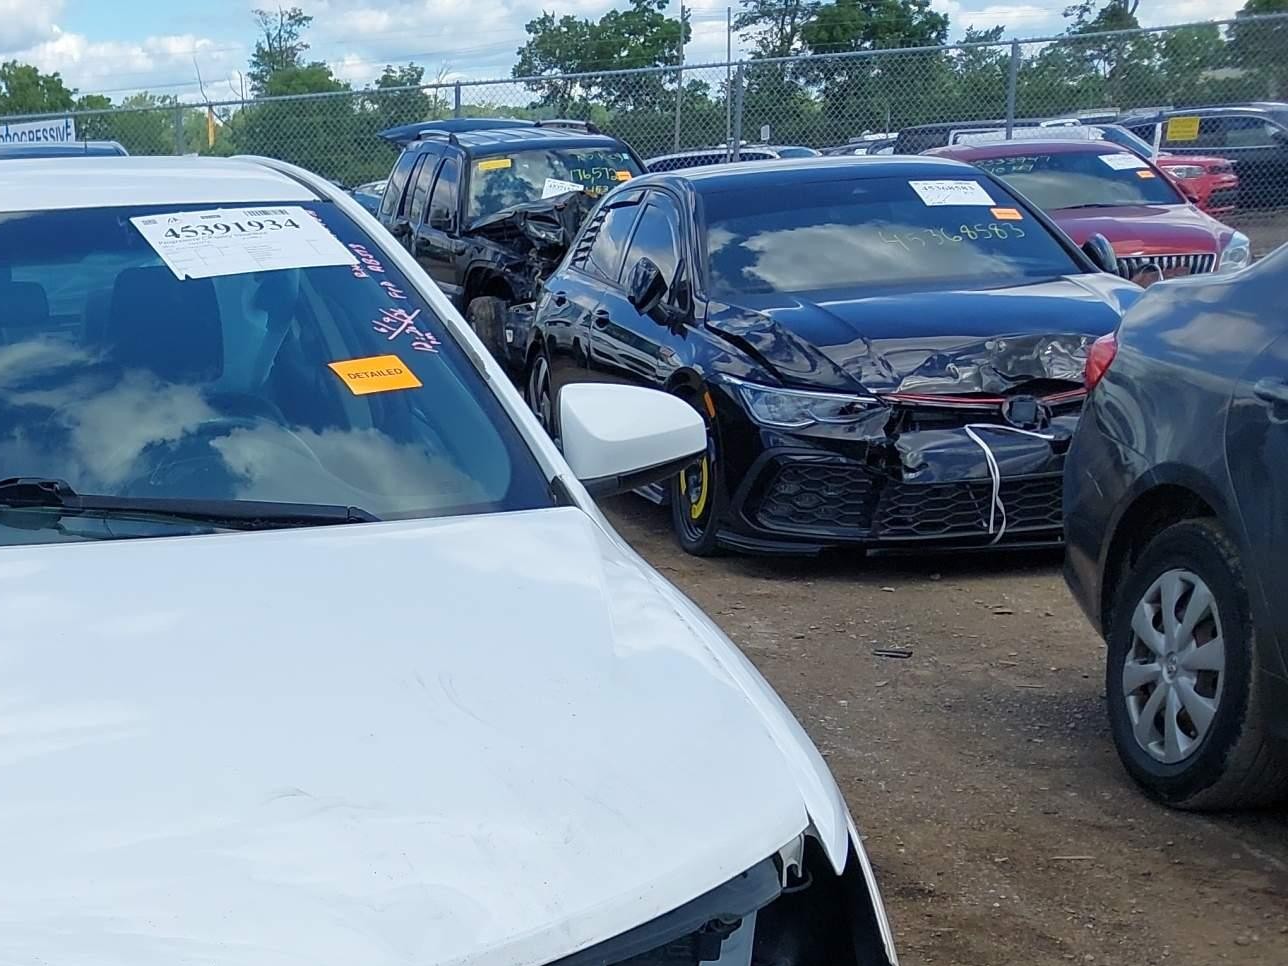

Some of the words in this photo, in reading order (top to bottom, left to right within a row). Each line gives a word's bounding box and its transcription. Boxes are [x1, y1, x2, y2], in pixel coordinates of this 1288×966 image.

[164, 218, 300, 239] 45391934
[878, 222, 1025, 251] 45368583
[347, 368, 403, 380] DETAILED
